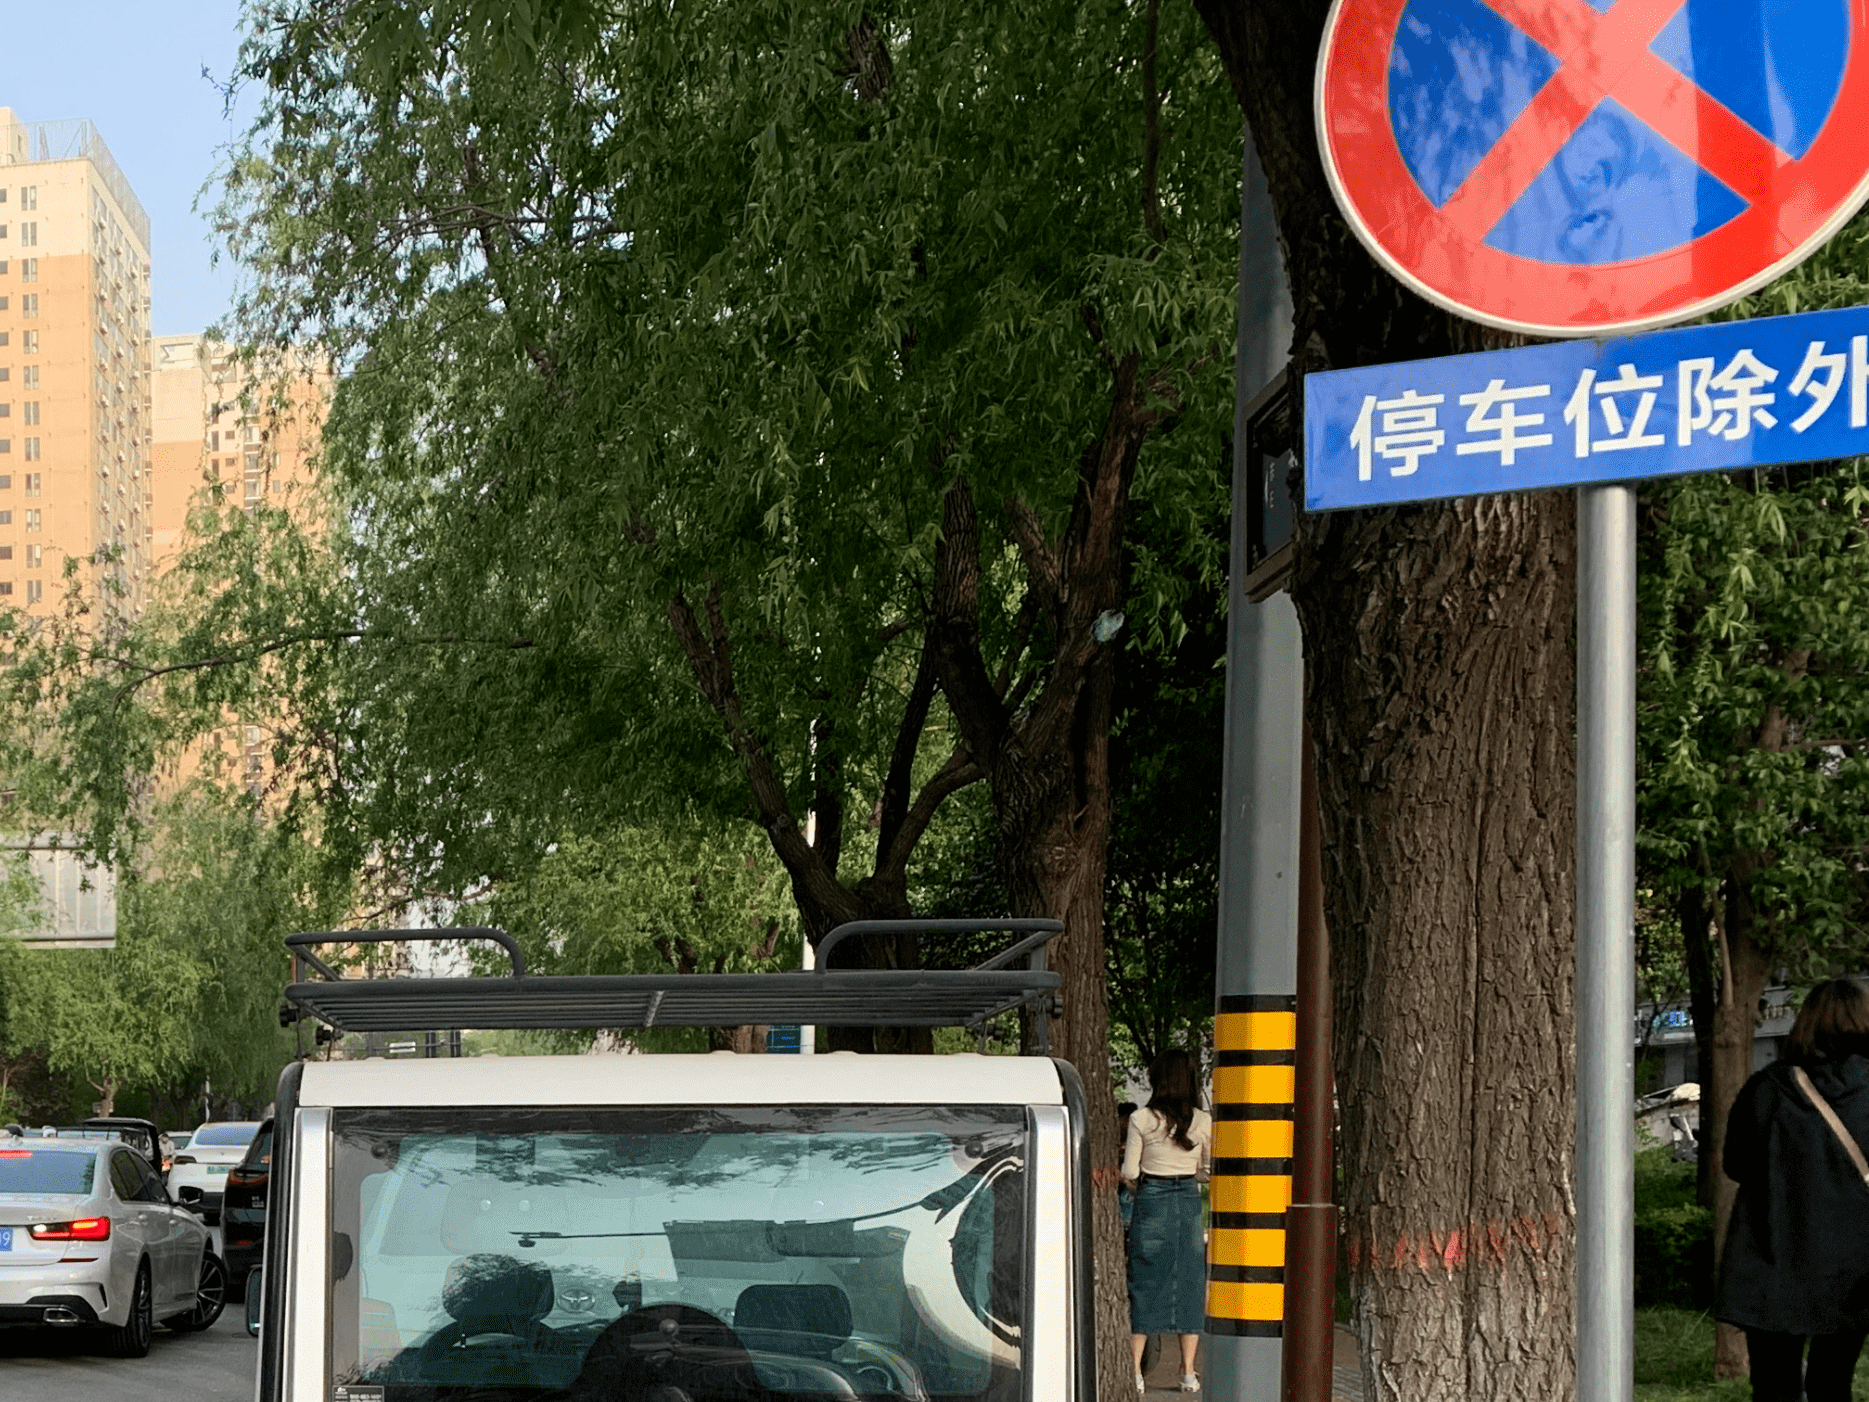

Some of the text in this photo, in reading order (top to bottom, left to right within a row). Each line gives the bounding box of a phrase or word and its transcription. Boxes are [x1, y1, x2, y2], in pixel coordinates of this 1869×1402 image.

[1349, 334, 1869, 482] 停车位除外
